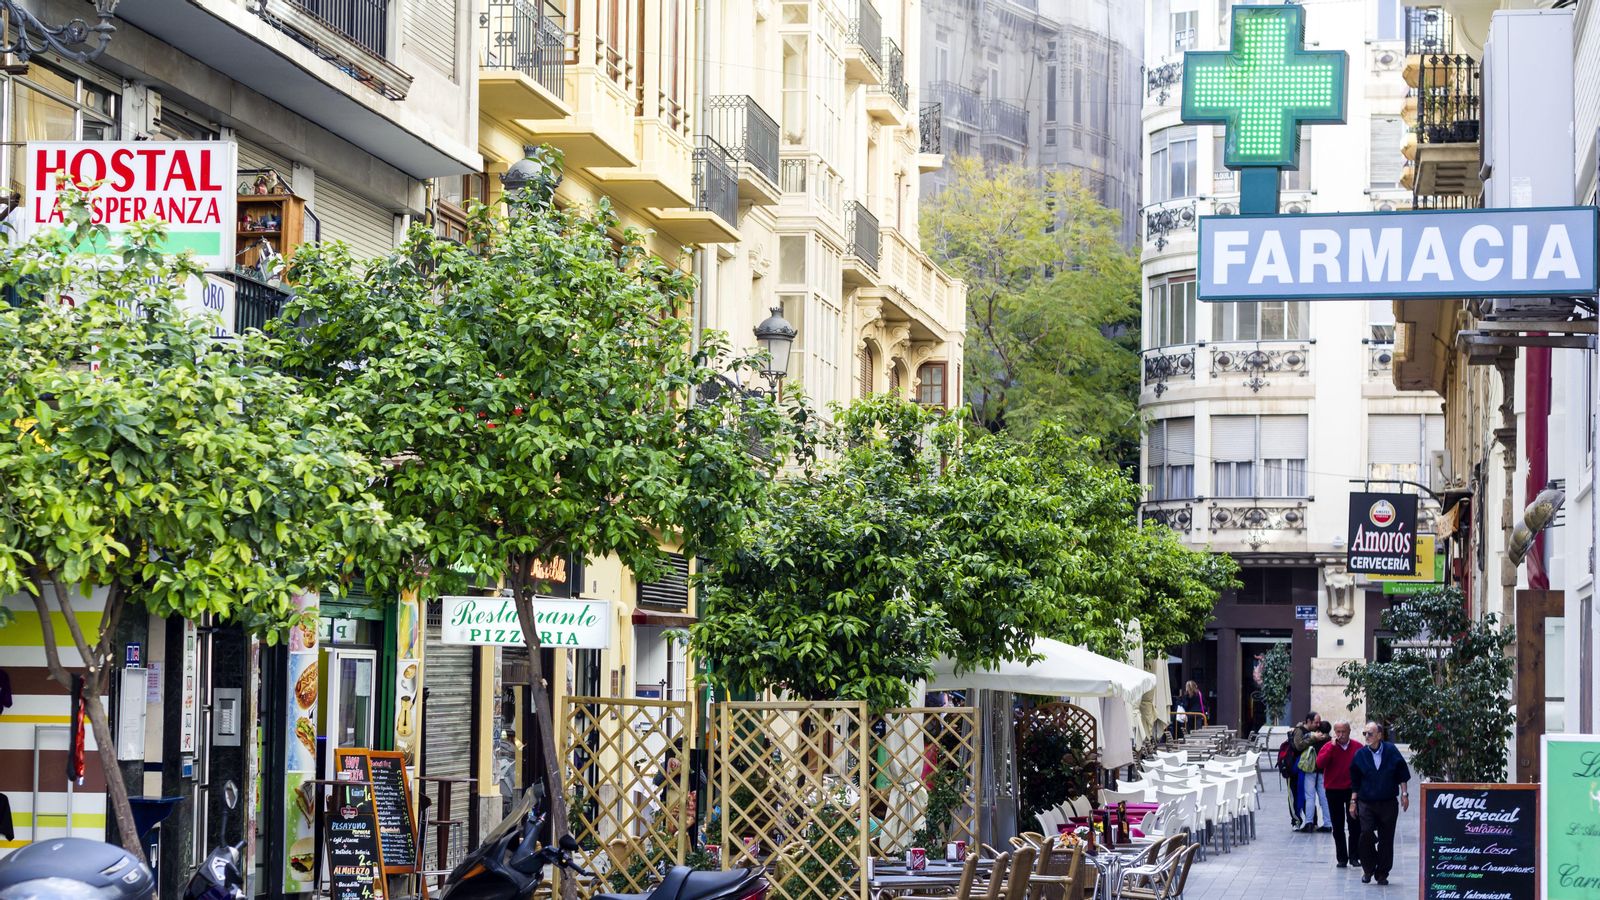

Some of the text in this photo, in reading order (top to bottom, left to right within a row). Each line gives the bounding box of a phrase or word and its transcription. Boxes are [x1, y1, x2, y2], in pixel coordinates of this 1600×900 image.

[36, 148, 222, 192] HOSTAL
[35, 196, 221, 224] LA SPERANZA
[1212, 223, 1581, 285] FARMACIA
[1351, 522, 1411, 553] Amorós
[1350, 554, 1410, 571] CERVECERÍA
[451, 599, 601, 627] Restarante
[470, 628, 579, 645] PIZZRIA
[1433, 792, 1489, 810] Menú
[1456, 807, 1521, 823] Especial
[1438, 846, 1481, 854] Ensalada
[1436, 861, 1468, 870] Crema
